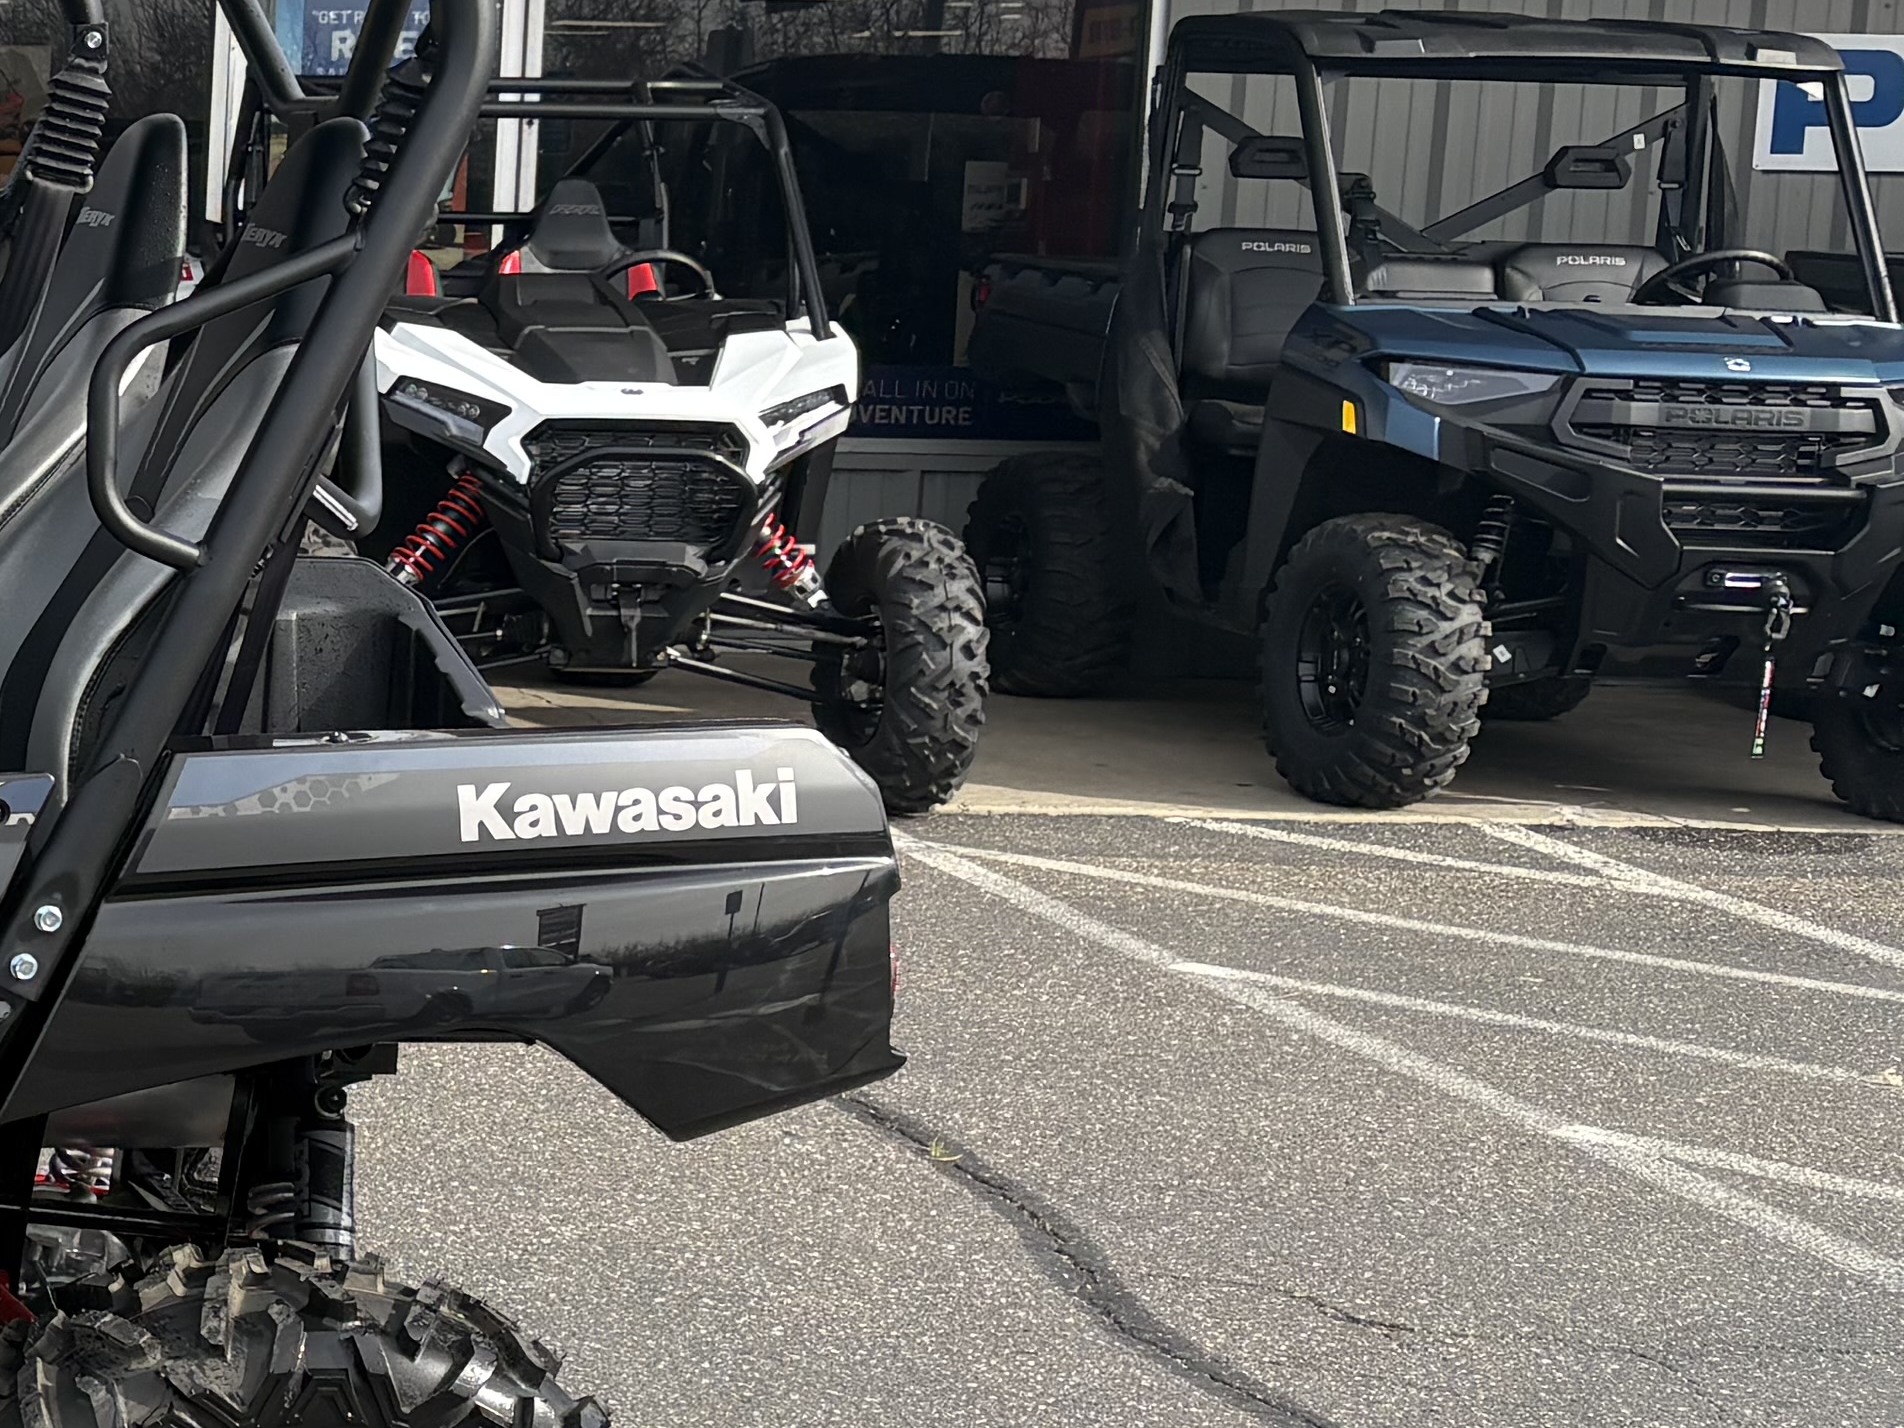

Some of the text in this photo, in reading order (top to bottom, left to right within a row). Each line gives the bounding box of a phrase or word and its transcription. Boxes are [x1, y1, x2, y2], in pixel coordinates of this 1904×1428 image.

[330, 29, 419, 62] RE
[1769, 50, 1904, 155] P
[1241, 241, 1312, 254] POLARIS
[1556, 254, 1626, 267] POLARIS
[1665, 405, 1805, 428] POLARIS
[456, 767, 798, 842] Kawasaki
